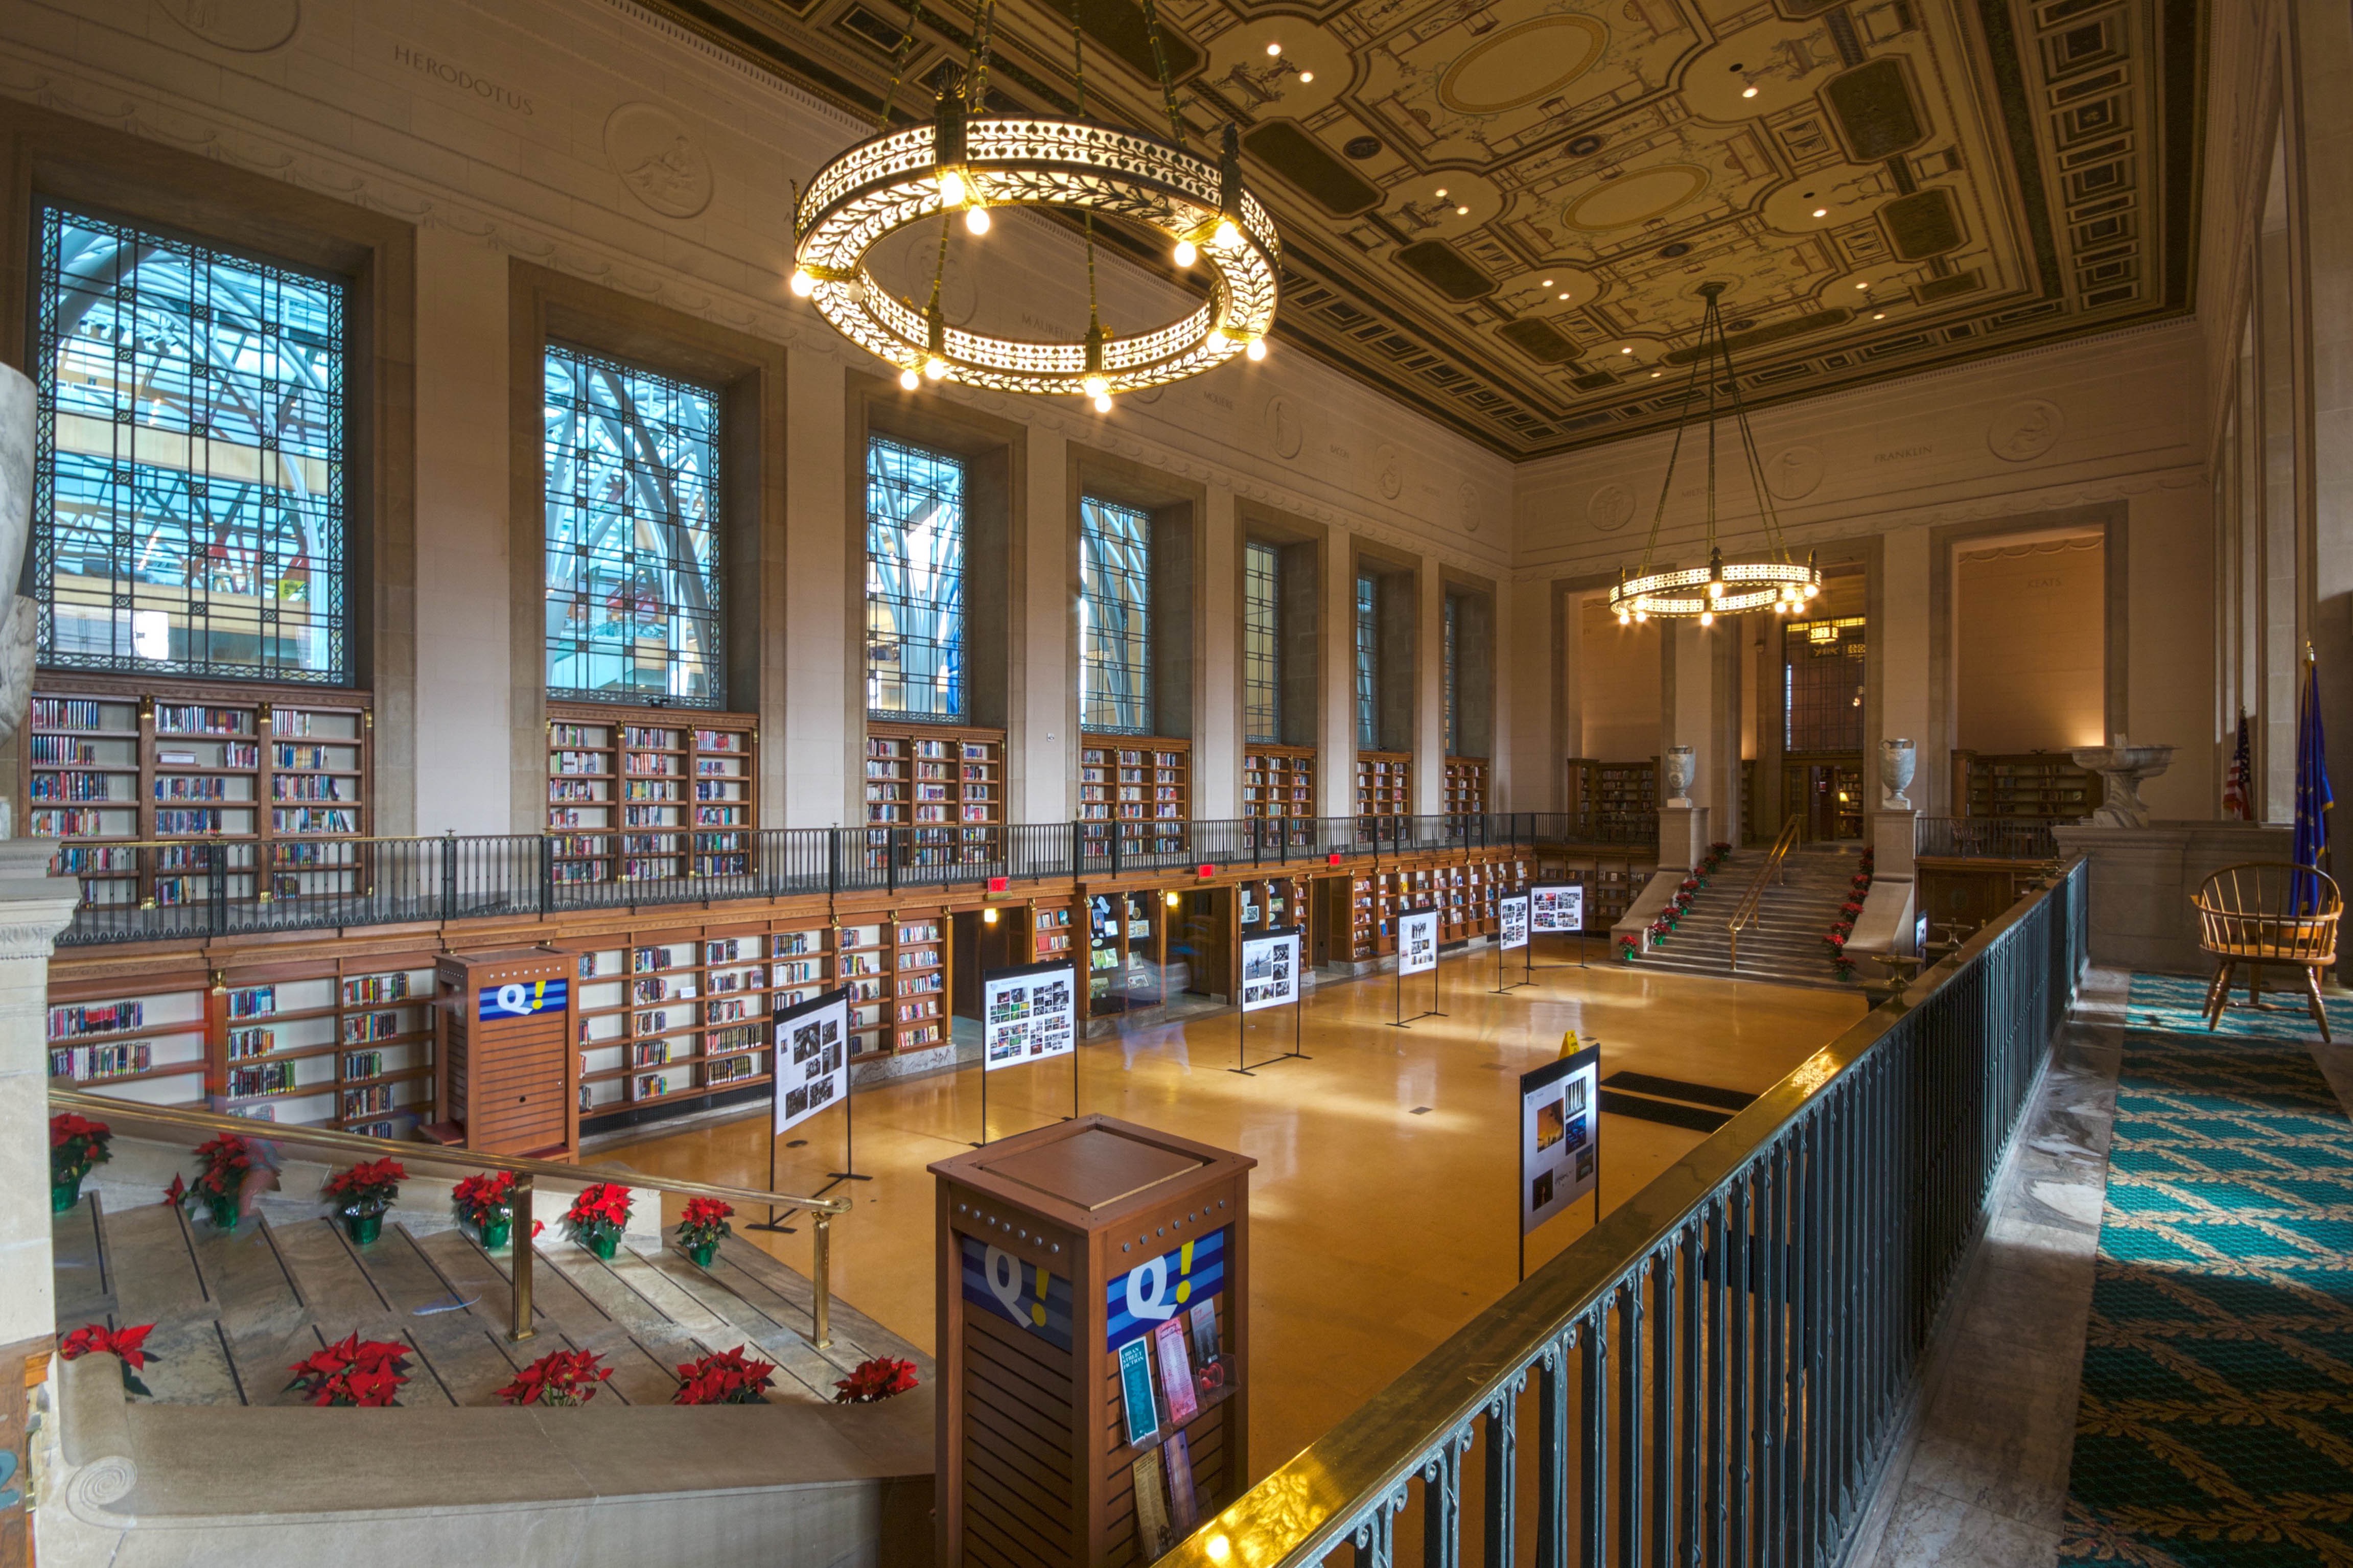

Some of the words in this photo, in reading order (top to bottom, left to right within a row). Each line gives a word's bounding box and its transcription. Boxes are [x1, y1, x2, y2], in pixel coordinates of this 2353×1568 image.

[394, 45, 533, 116] HERODOTUS
[1874, 444, 1933, 464] FRANKLIN
[2028, 578, 2061, 589] KEATS
[498, 980, 546, 1015] Q!
[985, 1245, 1050, 1328] Q!
[1126, 1241, 1195, 1320] Q!
[1122, 1347, 1139, 1359] URBAN
[1123, 1351, 1142, 1364] STREET
[1123, 1356, 1144, 1370] FICTION
